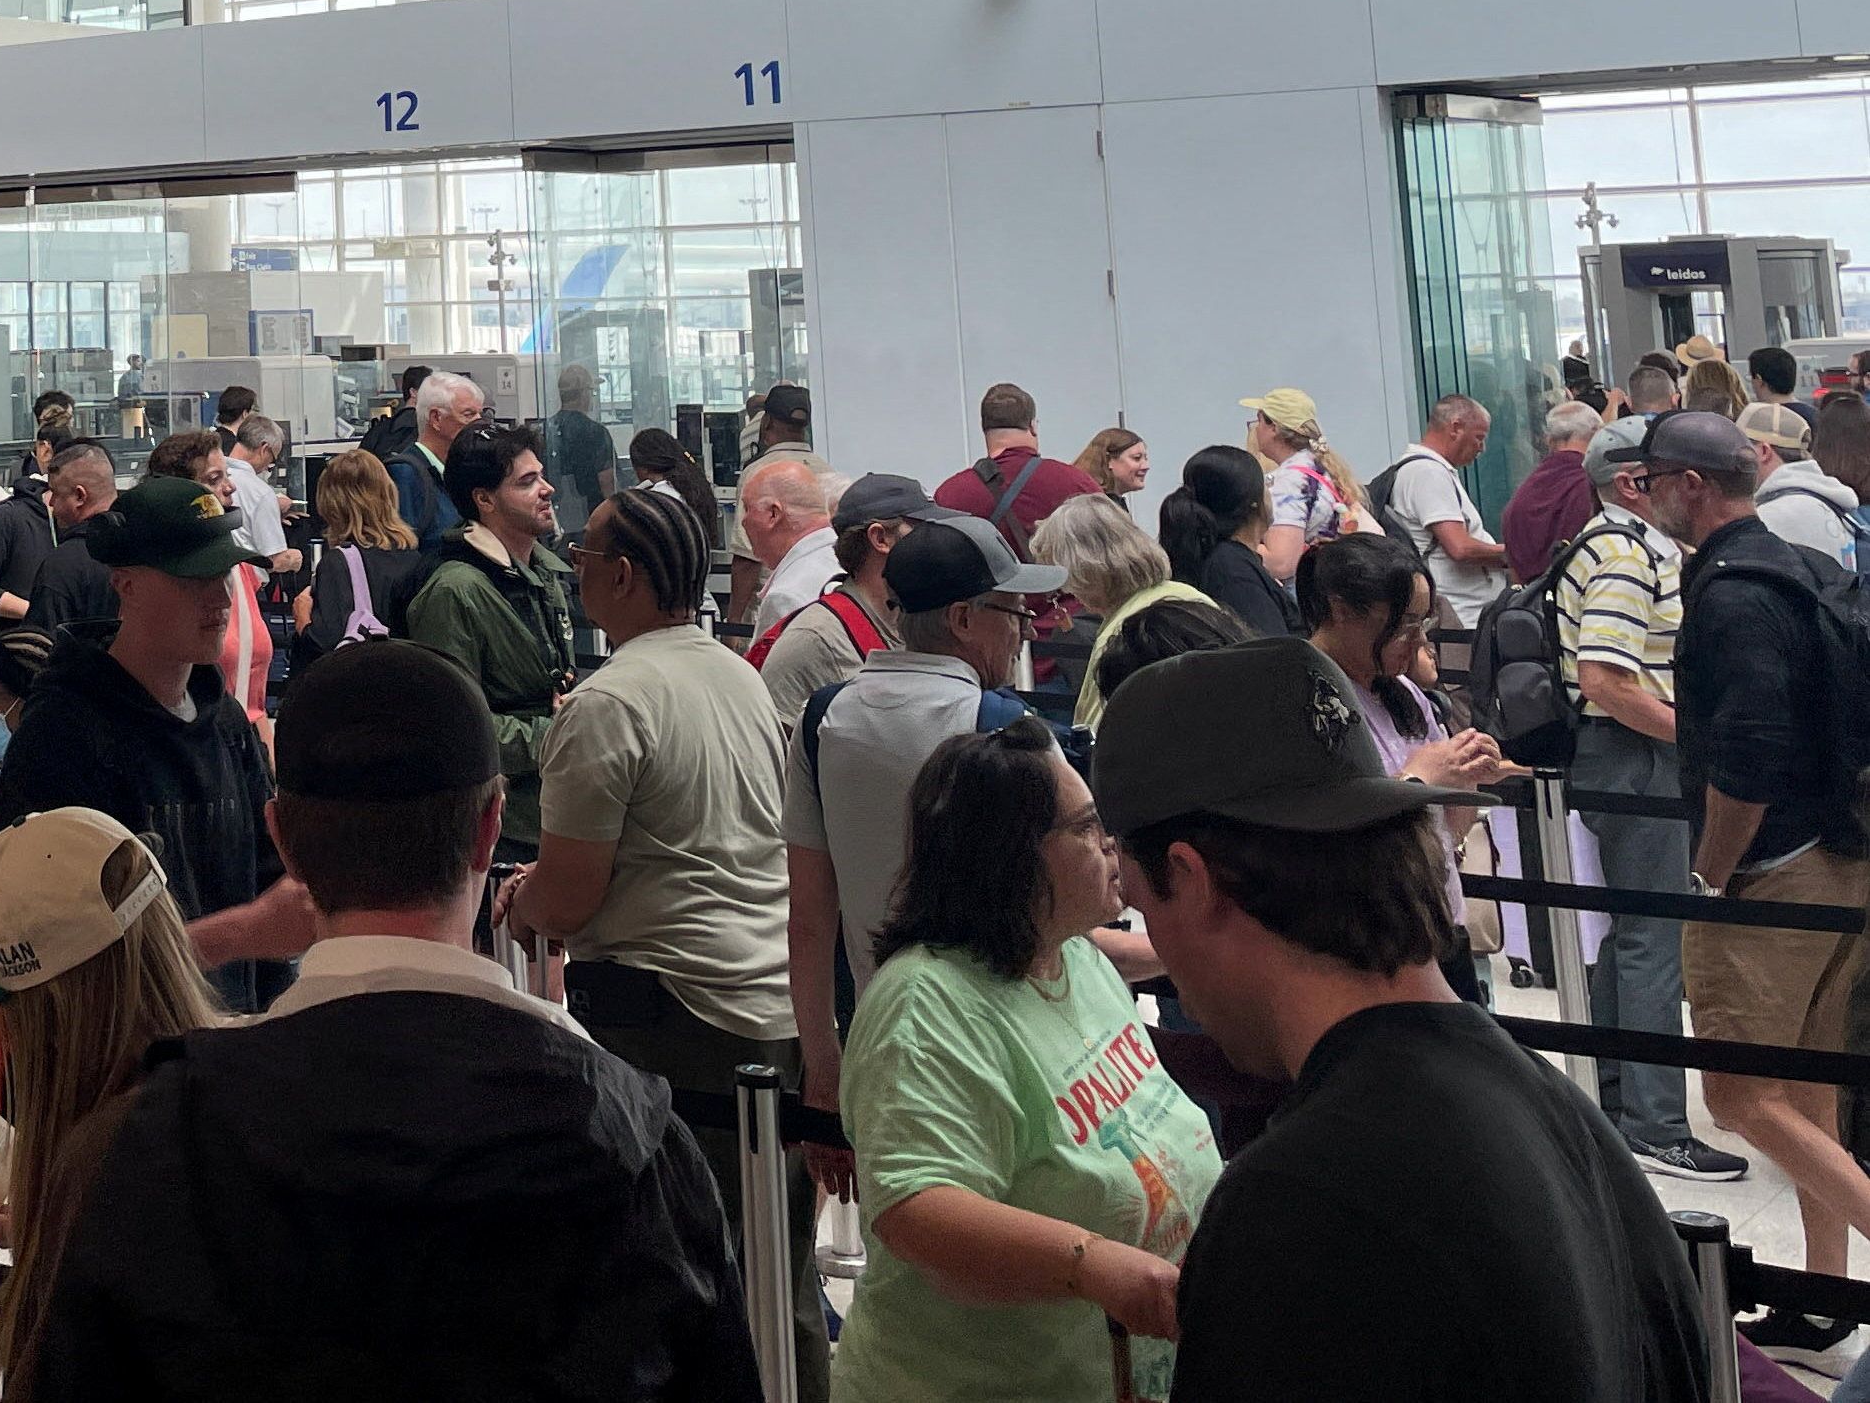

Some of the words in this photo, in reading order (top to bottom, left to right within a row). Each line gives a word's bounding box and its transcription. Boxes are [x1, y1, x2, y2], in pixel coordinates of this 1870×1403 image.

[734, 60, 781, 106] 11
[376, 90, 420, 132] 12
[1666, 267, 1707, 280] leidos
